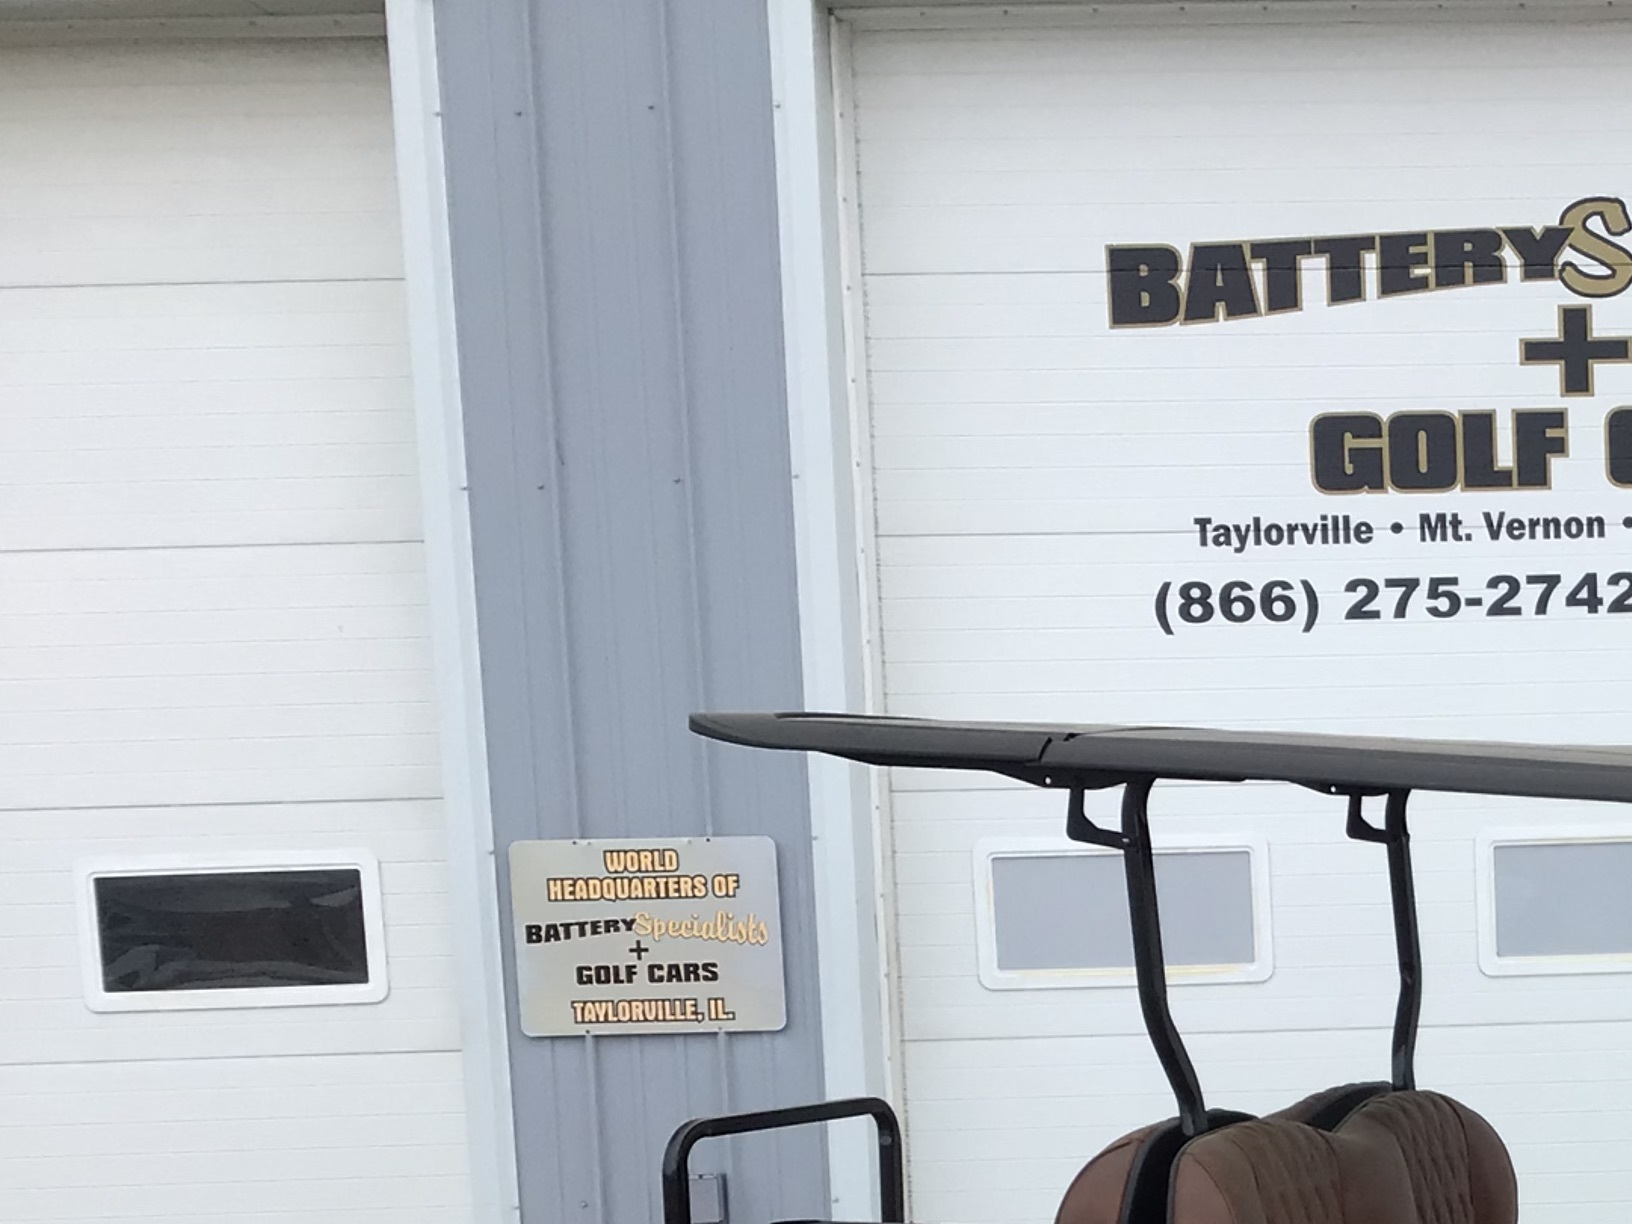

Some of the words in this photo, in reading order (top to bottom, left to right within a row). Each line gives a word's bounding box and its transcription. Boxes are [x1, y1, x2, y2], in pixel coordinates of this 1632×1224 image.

[1106, 226, 1572, 328] BATTERY
[1309, 408, 1570, 494] GOLF
[1194, 515, 1374, 554] Taylorville
[1418, 513, 1472, 543] Mt.
[1482, 511, 1606, 541] Vernon
[1155, 580, 1319, 634] (866)
[603, 849, 679, 873] WORLD
[547, 875, 707, 902] HEADQUARTERS
[711, 874, 740, 897] OF
[525, 918, 637, 944] BATTERY
[633, 909, 769, 946] Specialists
[575, 965, 638, 986] GOLF
[647, 962, 720, 984] CARS
[571, 998, 704, 1024] TAYLORVILLE,
[708, 998, 736, 1021] IL.
